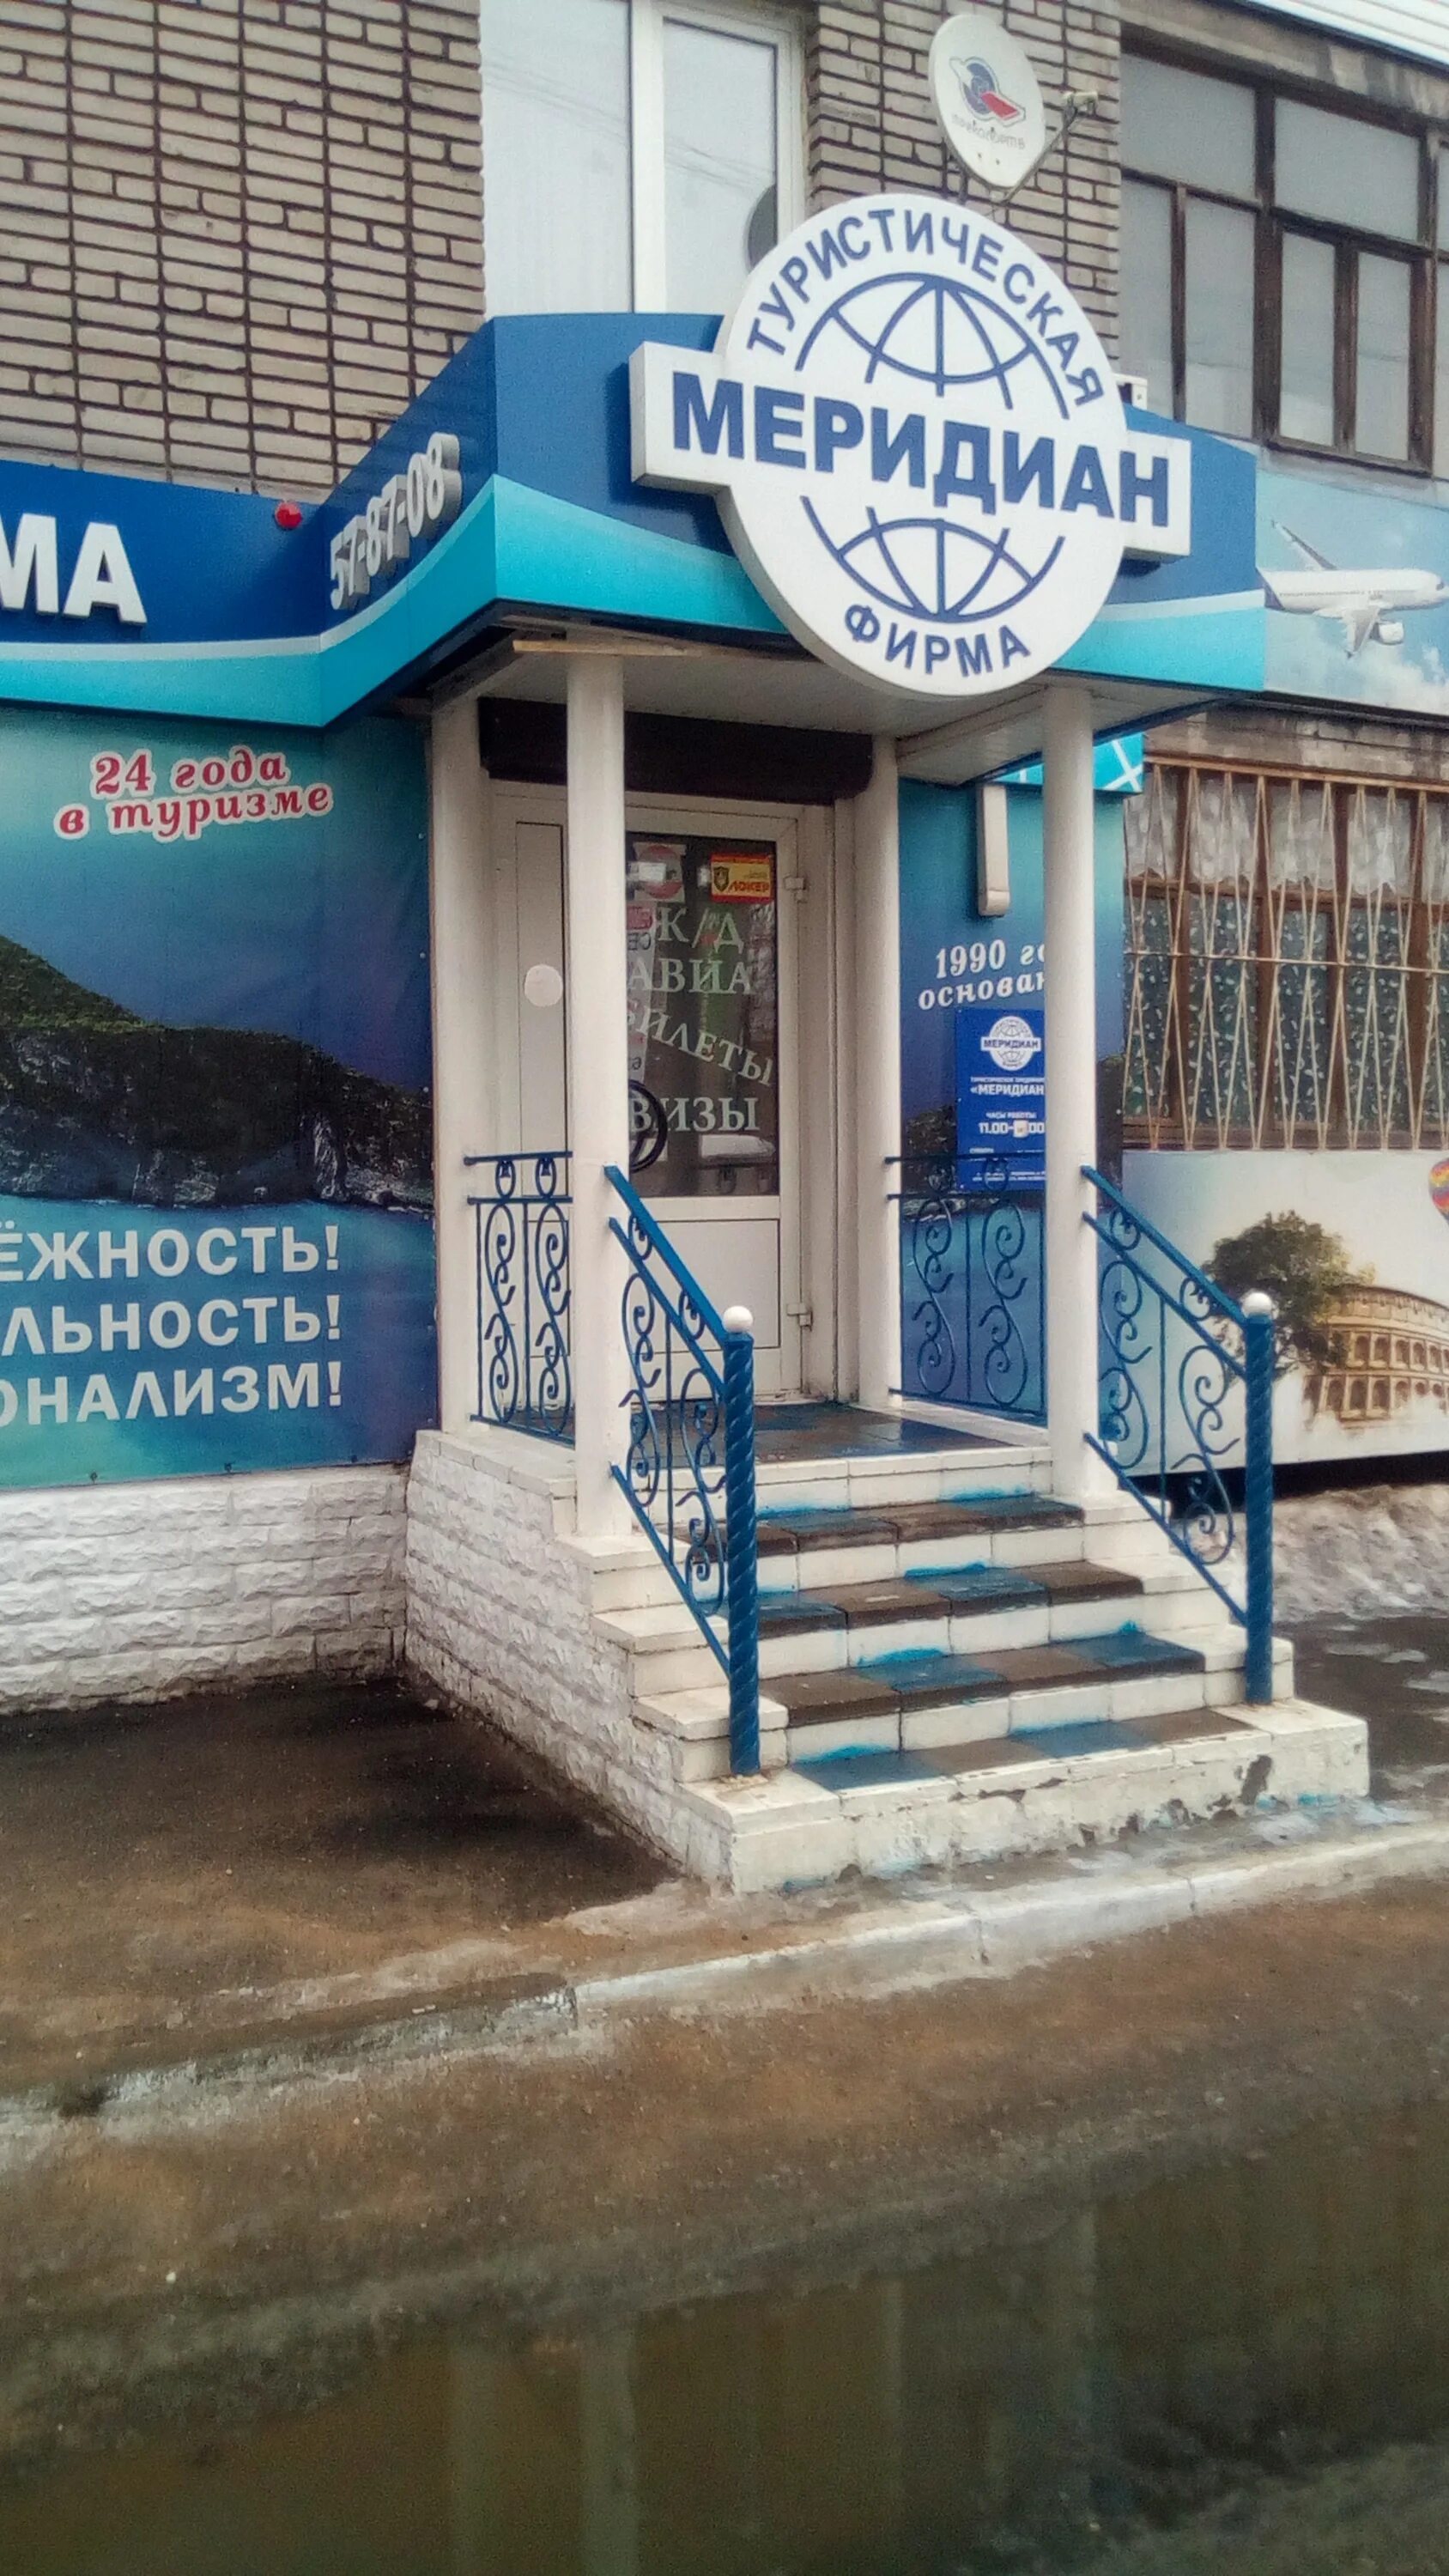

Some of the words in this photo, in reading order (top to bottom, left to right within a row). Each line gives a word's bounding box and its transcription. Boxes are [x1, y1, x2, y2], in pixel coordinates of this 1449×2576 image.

[748, 209, 1105, 407] ТУРИСТИЧЕСКАЯ
[671, 371, 1169, 529] МЕРИДИАН
[330, 431, 463, 611] 57-87-08
[844, 603, 1029, 678] ФИРМА
[93, 752, 154, 796] 24
[173, 746, 288, 791] года
[58, 807, 87, 836] в
[110, 785, 330, 839] туризме
[627, 957, 753, 995] АВИА
[935, 939, 1007, 980] 1990
[983, 1038, 1039, 1049] МЕРИДИАН
